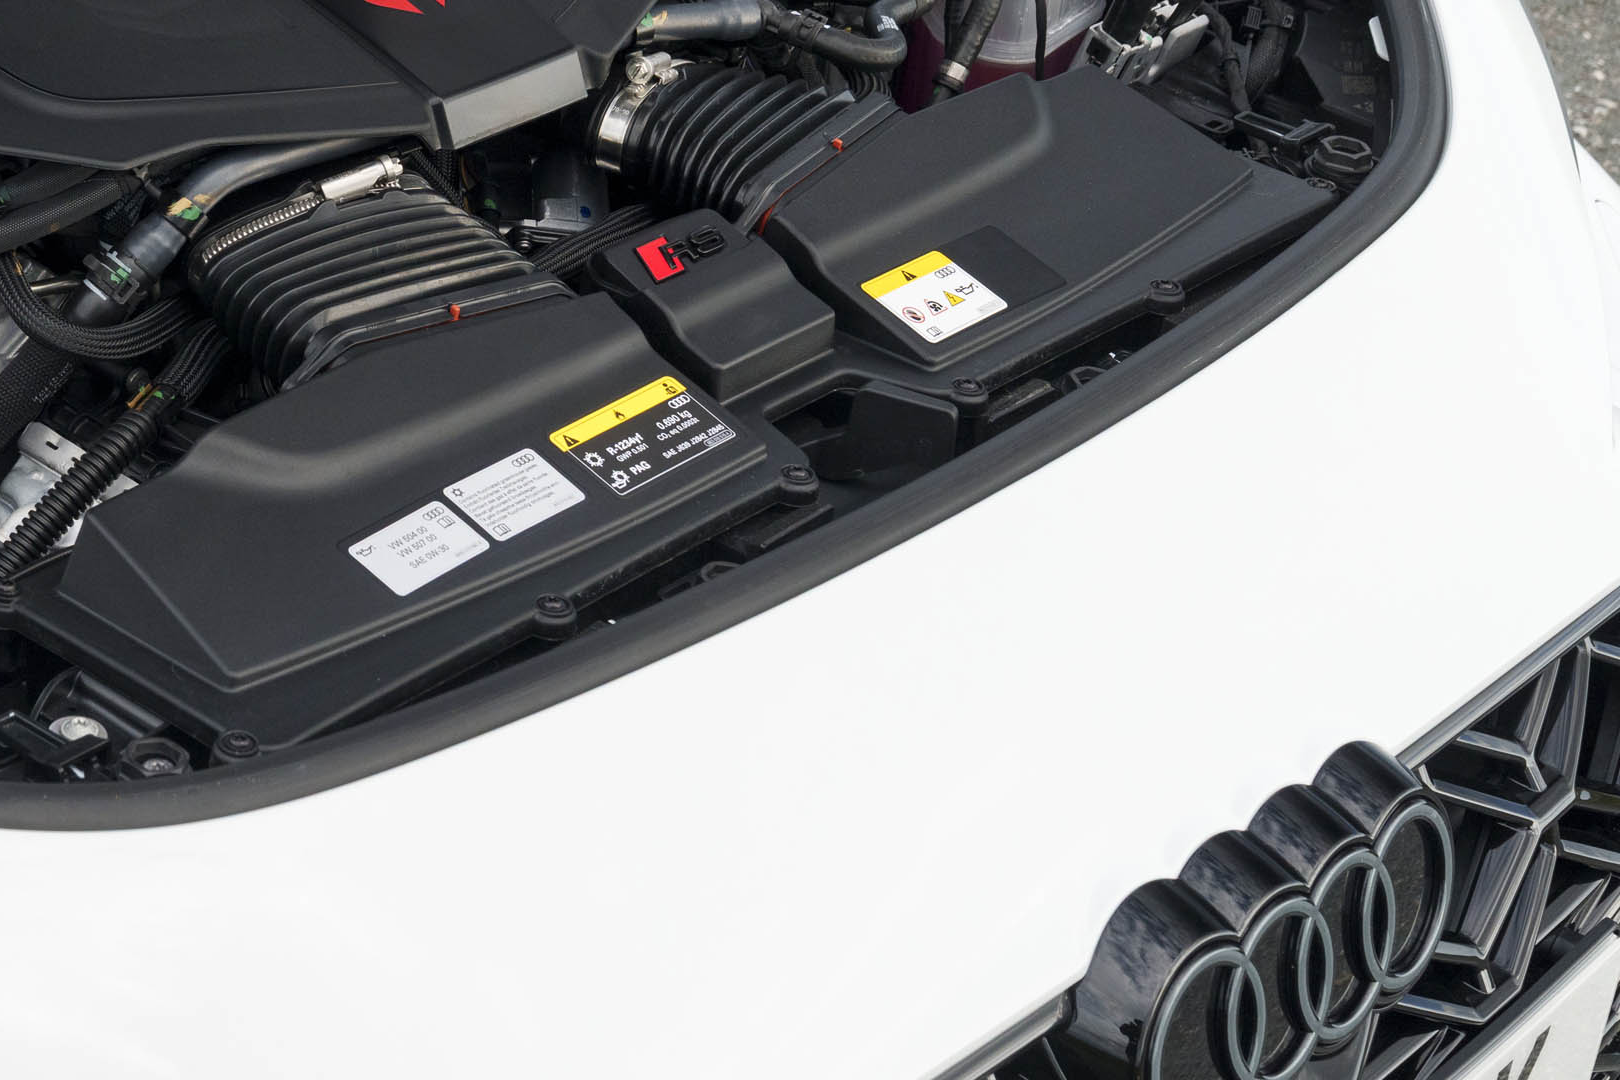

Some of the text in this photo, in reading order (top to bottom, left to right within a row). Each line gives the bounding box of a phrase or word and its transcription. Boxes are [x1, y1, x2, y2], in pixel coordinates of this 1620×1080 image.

[650, 224, 726, 276] RS
[677, 409, 693, 419] kg
[605, 432, 644, 456] R-1234yf
[629, 460, 652, 475] PAG
[387, 538, 404, 550] VW
[396, 546, 413, 557] VW
